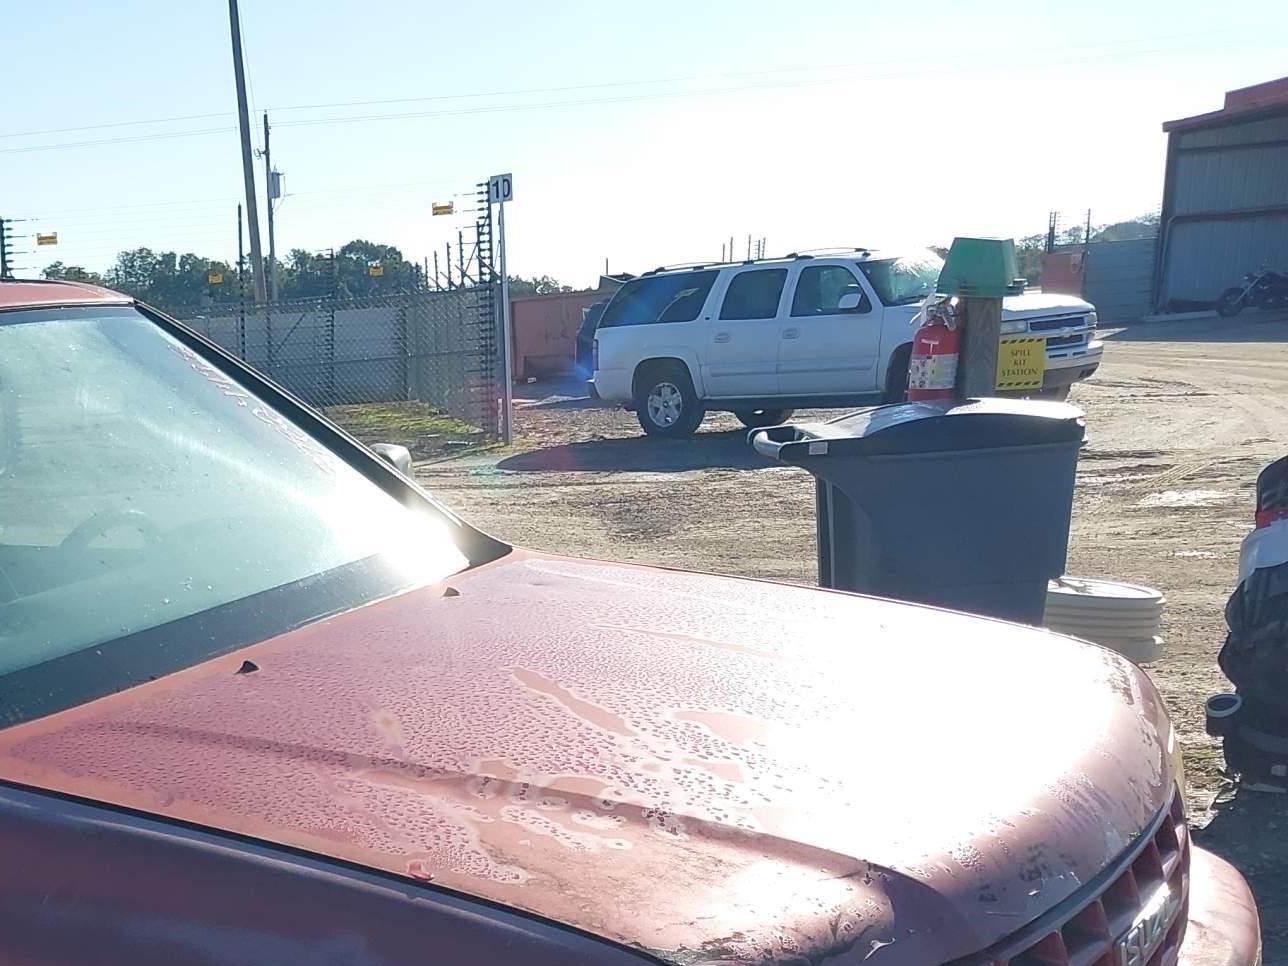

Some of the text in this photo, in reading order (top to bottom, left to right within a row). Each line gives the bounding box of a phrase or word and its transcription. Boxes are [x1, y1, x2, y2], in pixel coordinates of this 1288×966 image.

[1011, 348, 1030, 357] SPILL
[1013, 359, 1026, 367] KIT
[1001, 368, 1039, 377] STATION
